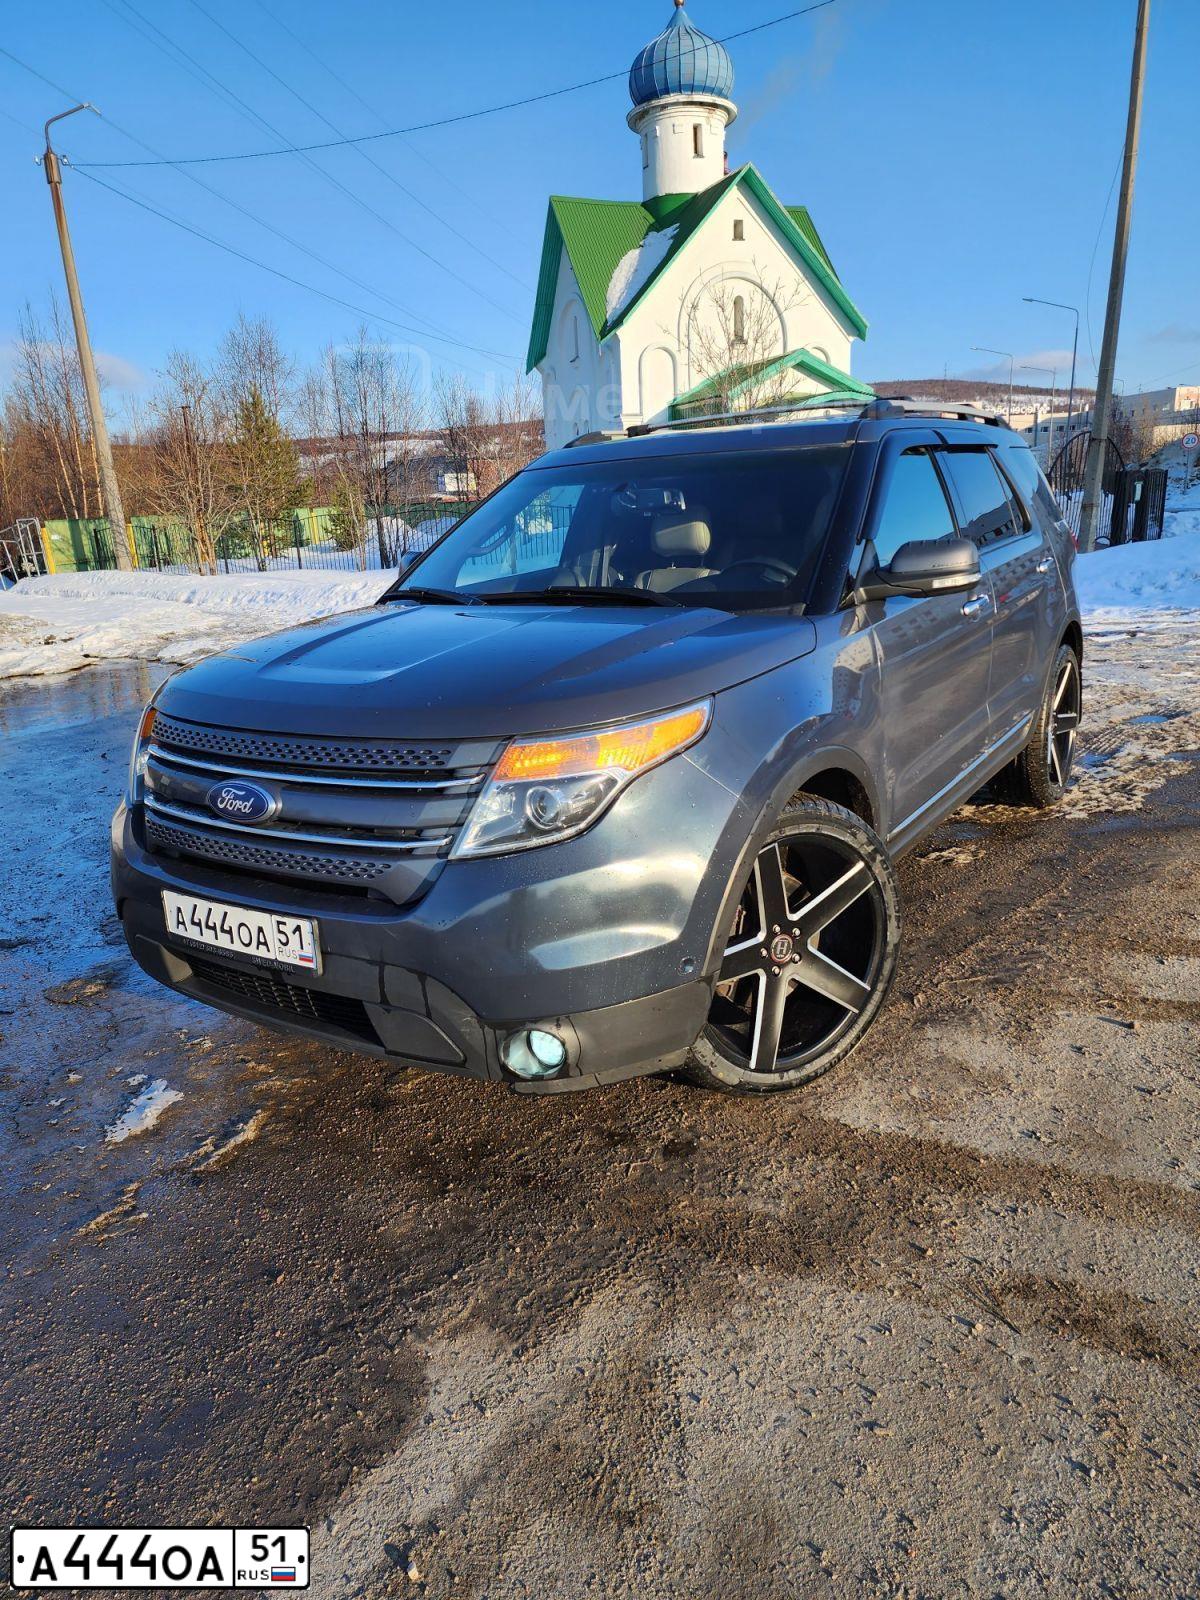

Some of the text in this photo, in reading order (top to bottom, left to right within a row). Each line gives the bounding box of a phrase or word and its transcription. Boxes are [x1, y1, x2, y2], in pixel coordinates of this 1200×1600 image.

[1185, 436, 1196, 445] 20
[217, 788, 254, 814] Ford
[276, 920, 305, 950] 51
[277, 945, 298, 960] RUS
